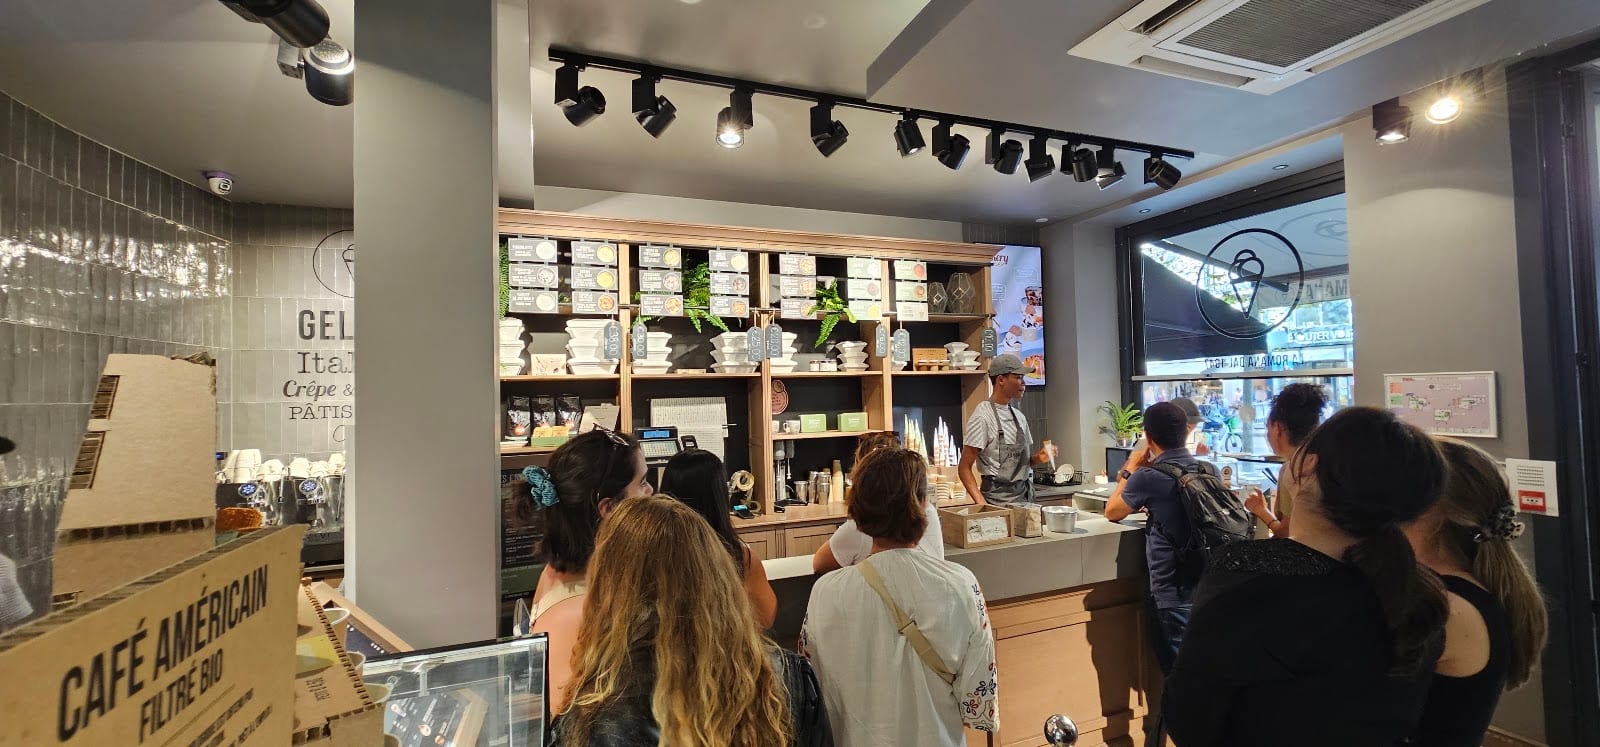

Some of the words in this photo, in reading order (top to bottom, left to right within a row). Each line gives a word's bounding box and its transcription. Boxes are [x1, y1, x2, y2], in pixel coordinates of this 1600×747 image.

[283, 380, 337, 401] Crêpe
[58, 617, 148, 743] CAFÉ
[153, 564, 269, 681] AMÉRICAIN
[139, 660, 197, 745] FILTRÉ
[199, 647, 224, 697] BIO
